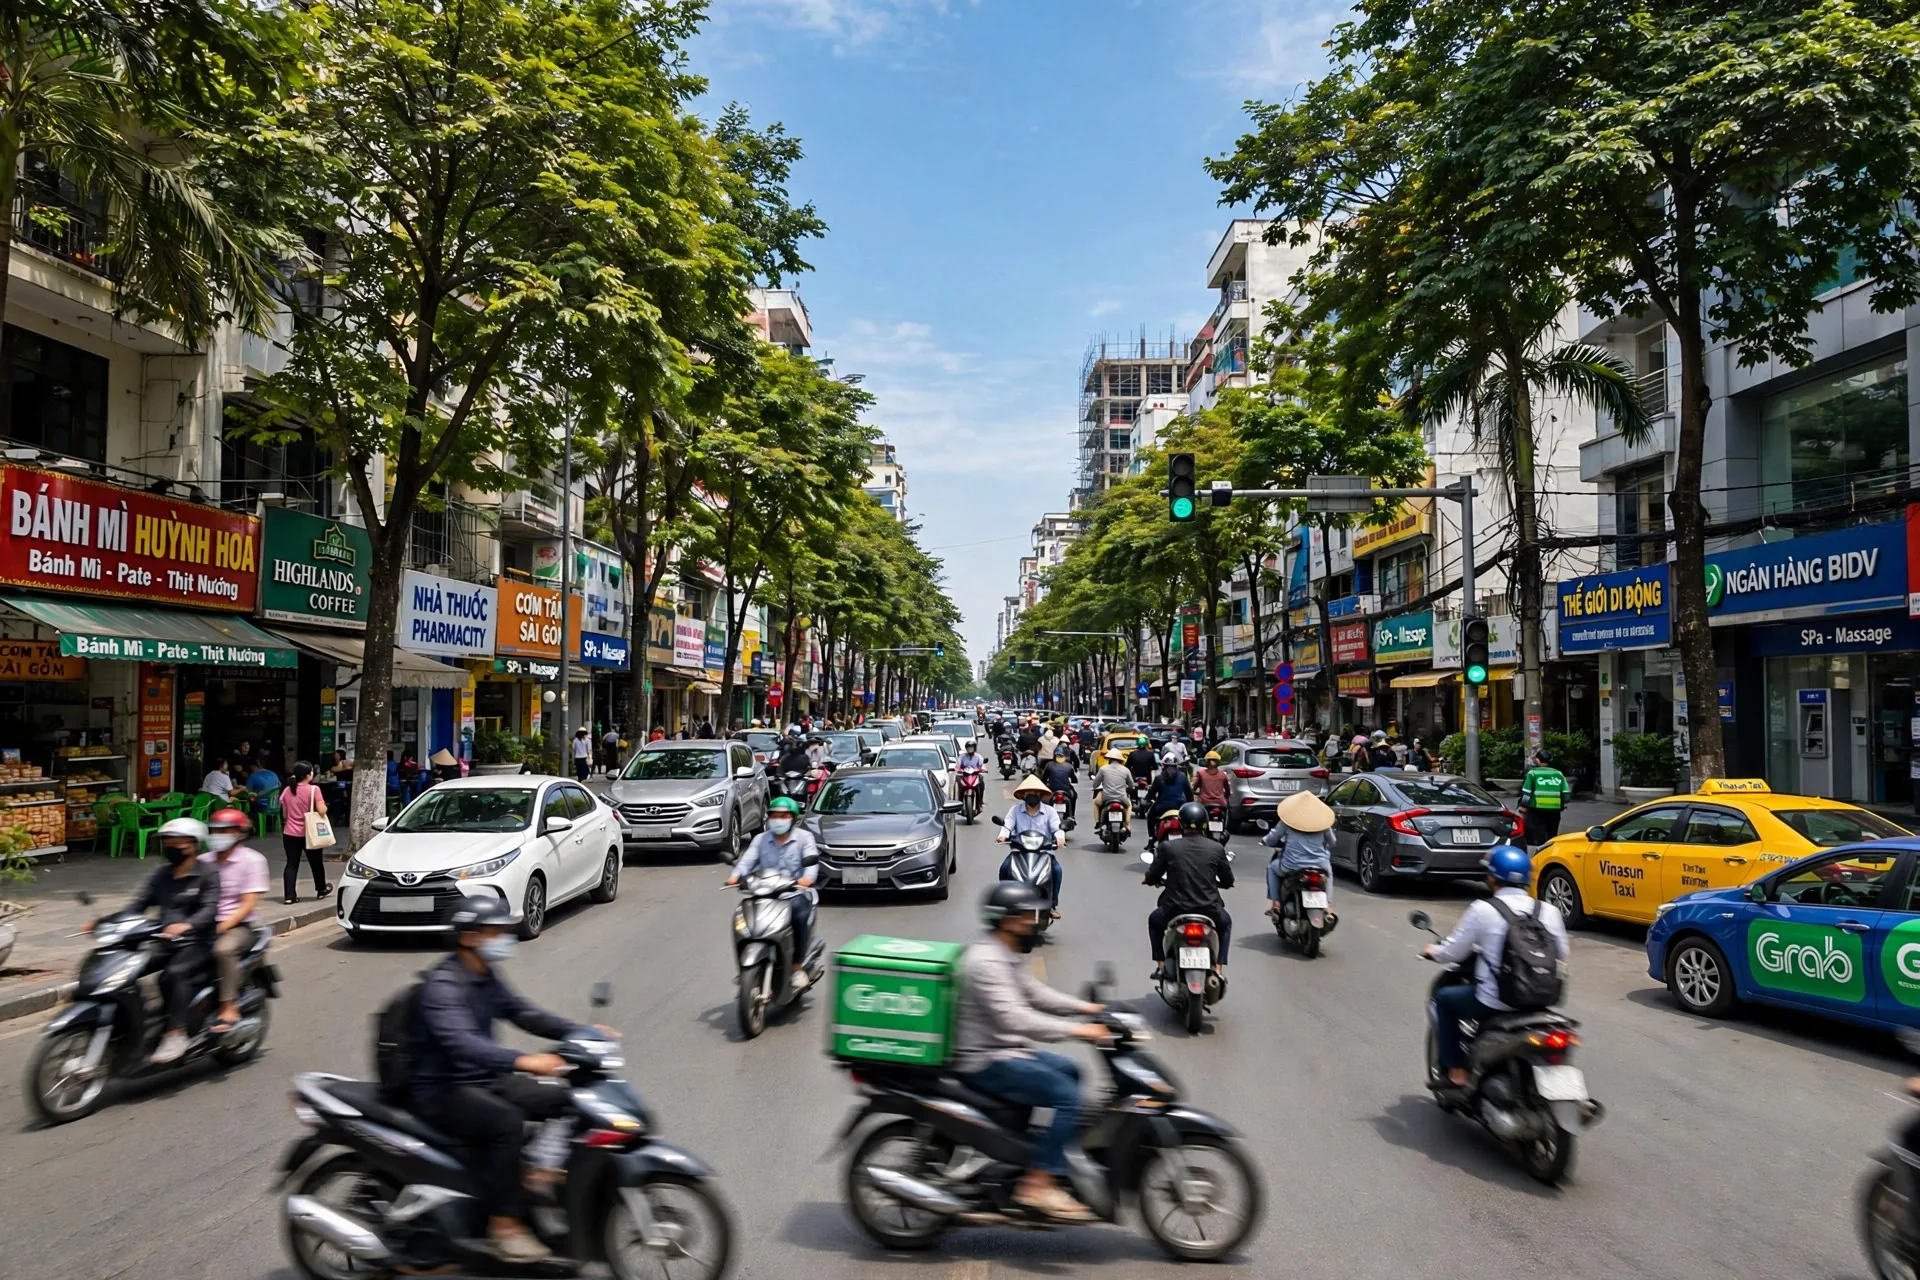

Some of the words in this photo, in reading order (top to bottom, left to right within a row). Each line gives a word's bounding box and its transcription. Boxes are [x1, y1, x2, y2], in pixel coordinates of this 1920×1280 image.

[11, 483, 90, 546] BÁNH
[97, 500, 128, 552] MÌ
[135, 510, 210, 565] HUỲNH
[216, 530, 255, 573] HOA
[29, 548, 75, 577] Bánh
[80, 557, 101, 580] Mì
[118, 562, 152, 586] Pate
[167, 570, 194, 595] Thịt
[197, 574, 239, 601] Nướng
[273, 559, 354, 593] HIGHLANDS
[1726, 563, 1770, 594] NGÂN
[1773, 556, 1823, 589] HÀNG
[1828, 548, 1879, 582] BIDV
[309, 593, 356, 614] COFFEE
[413, 582, 443, 614] NHÀ
[446, 588, 488, 621] THUỐC
[515, 591, 542, 616] CƠM
[1563, 581, 1583, 617] THẾ
[1585, 582, 1607, 616] GIỚI
[1610, 587, 1623, 612] DI
[1625, 576, 1662, 615] ĐỘNG
[412, 618, 486, 648] PHARMACITY
[520, 616, 540, 643] SÀI
[1801, 629, 1824, 646] SPa
[1835, 627, 1892, 645] Massage
[76, 636, 119, 655] Bánh
[123, 639, 143, 656] Mì
[157, 642, 189, 659] Pate
[200, 645, 224, 664] Thịt
[227, 647, 265, 666] Nướng
[1600, 860, 1644, 880] Vinasun
[1612, 880, 1636, 898] Taxi
[1756, 932, 1853, 983] Grab
